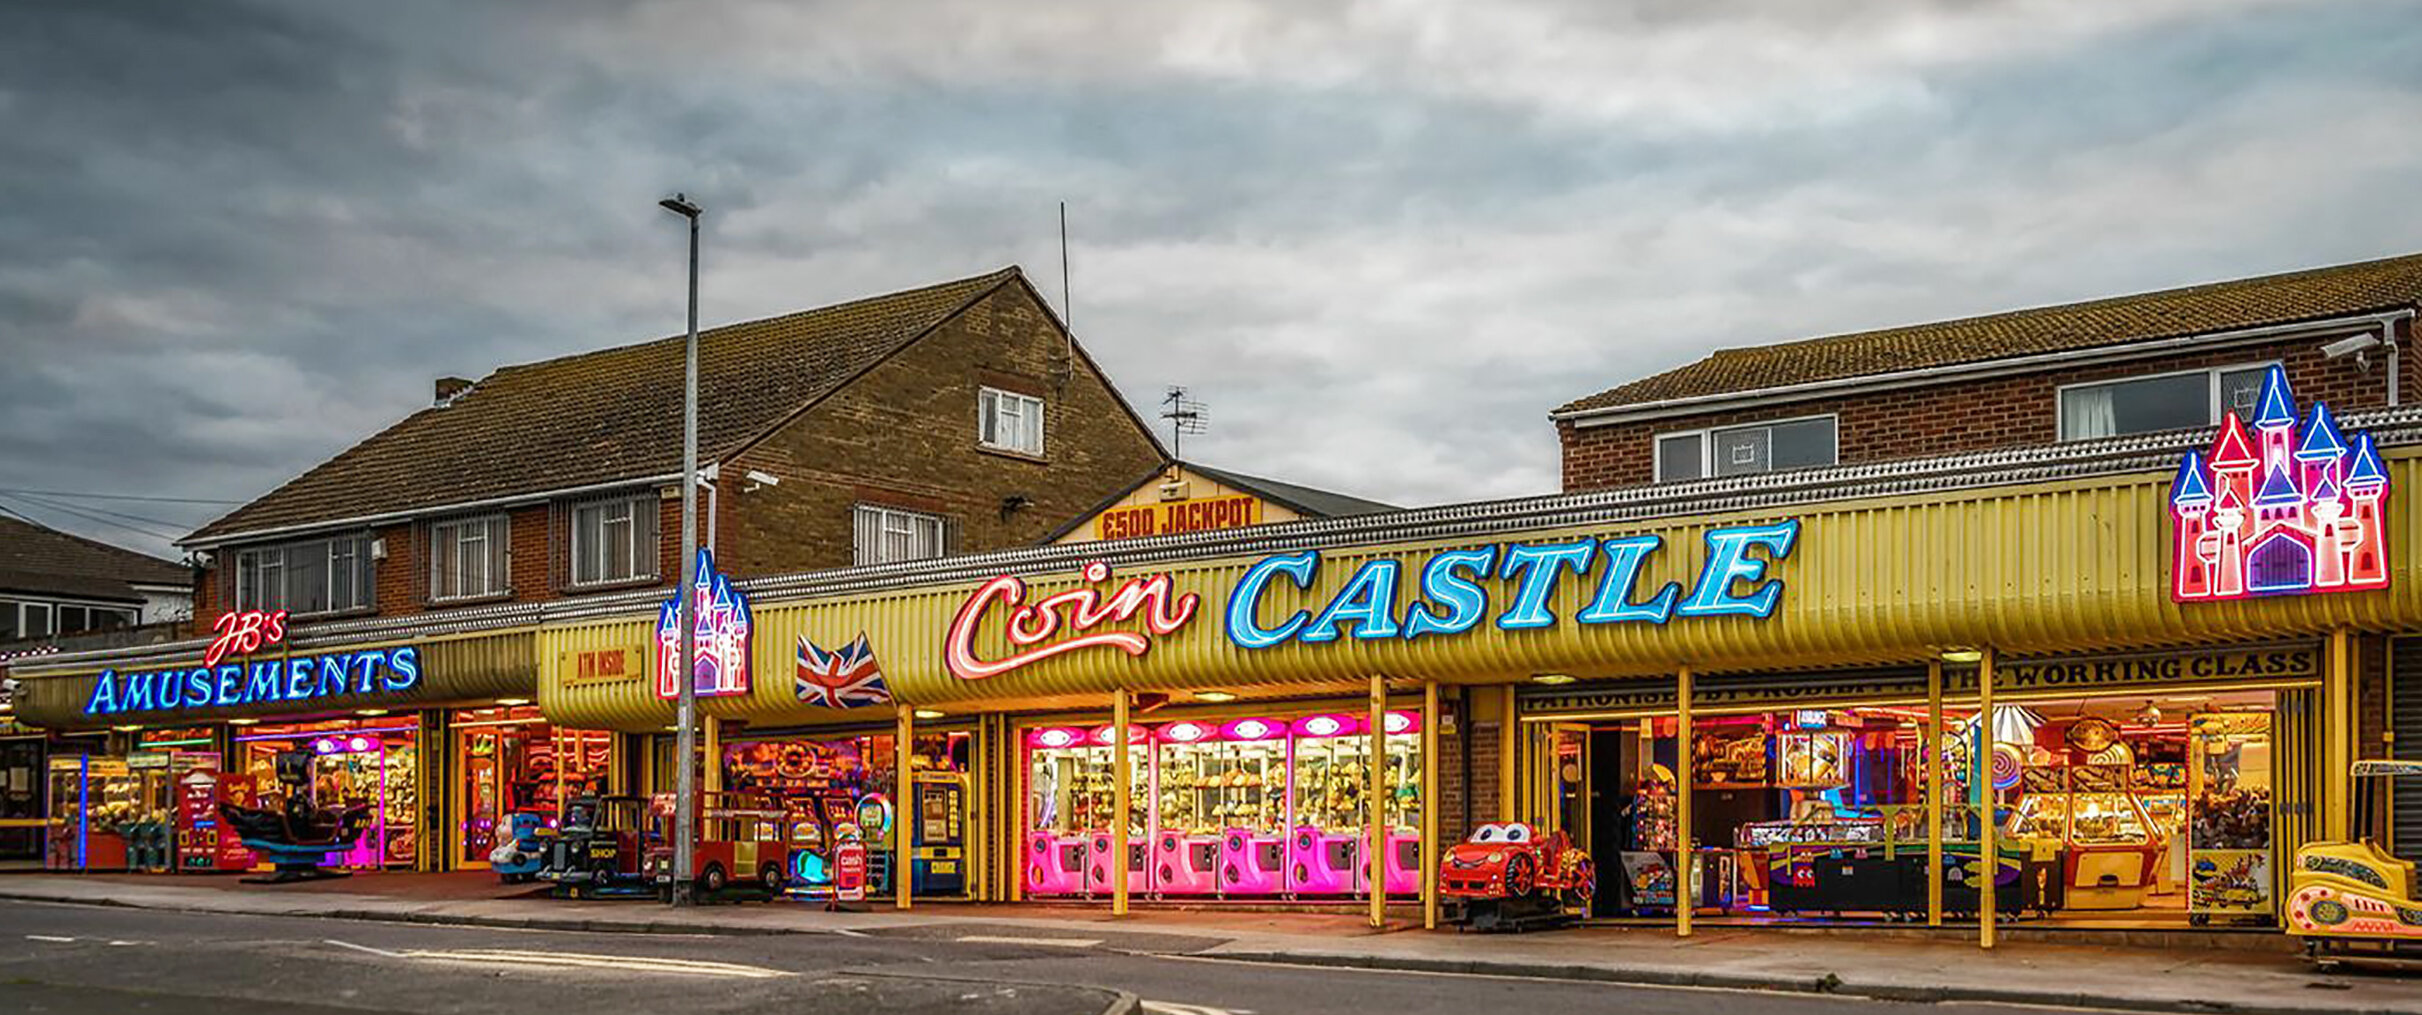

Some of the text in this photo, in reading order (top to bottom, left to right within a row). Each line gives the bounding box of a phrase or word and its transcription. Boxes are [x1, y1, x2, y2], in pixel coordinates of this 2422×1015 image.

[1102, 498, 1254, 541] £500 JACKPOT
[945, 517, 1800, 680] Coin CASTLE
[85, 646, 419, 714] AMUSEMENTS
[2013, 654, 2182, 687] WORKING
[2190, 649, 2312, 678] CLASS
[1526, 690, 1694, 710] PATRONISE
